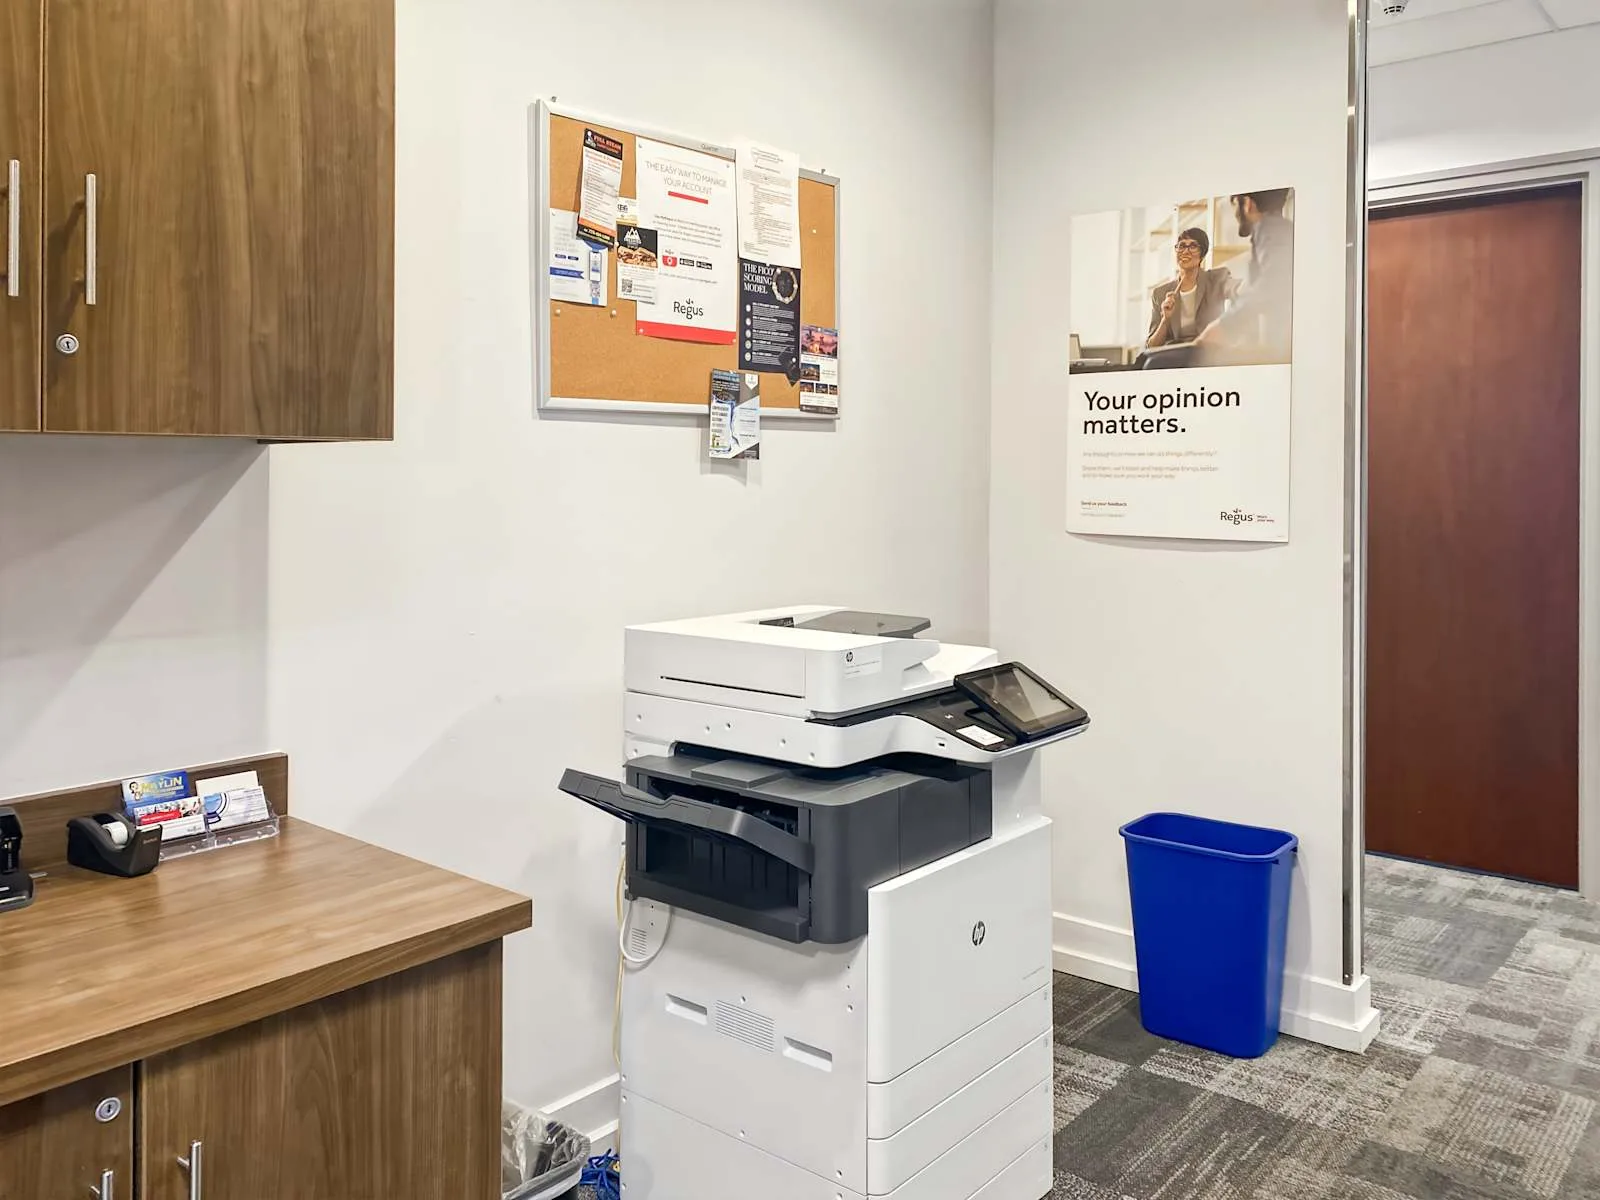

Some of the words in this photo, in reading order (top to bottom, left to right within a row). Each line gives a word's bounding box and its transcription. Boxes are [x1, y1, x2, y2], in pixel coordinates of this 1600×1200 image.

[645, 160, 660, 171] THE
[660, 163, 678, 175] EASY
[676, 167, 692, 178] WAY
[693, 171, 702, 182] TO
[702, 174, 728, 188] MANAGE
[664, 177, 681, 188] YOUR
[682, 181, 712, 195] ACCOUNT
[743, 263, 758, 274] THE
[743, 273, 773, 286] SCORING
[743, 282, 768, 295] MODEL
[673, 300, 704, 319] Regus
[1084, 391, 1137, 411] Your
[1143, 386, 1241, 415] opinion
[1083, 415, 1186, 435] matters.
[1220, 510, 1254, 526] Regus
